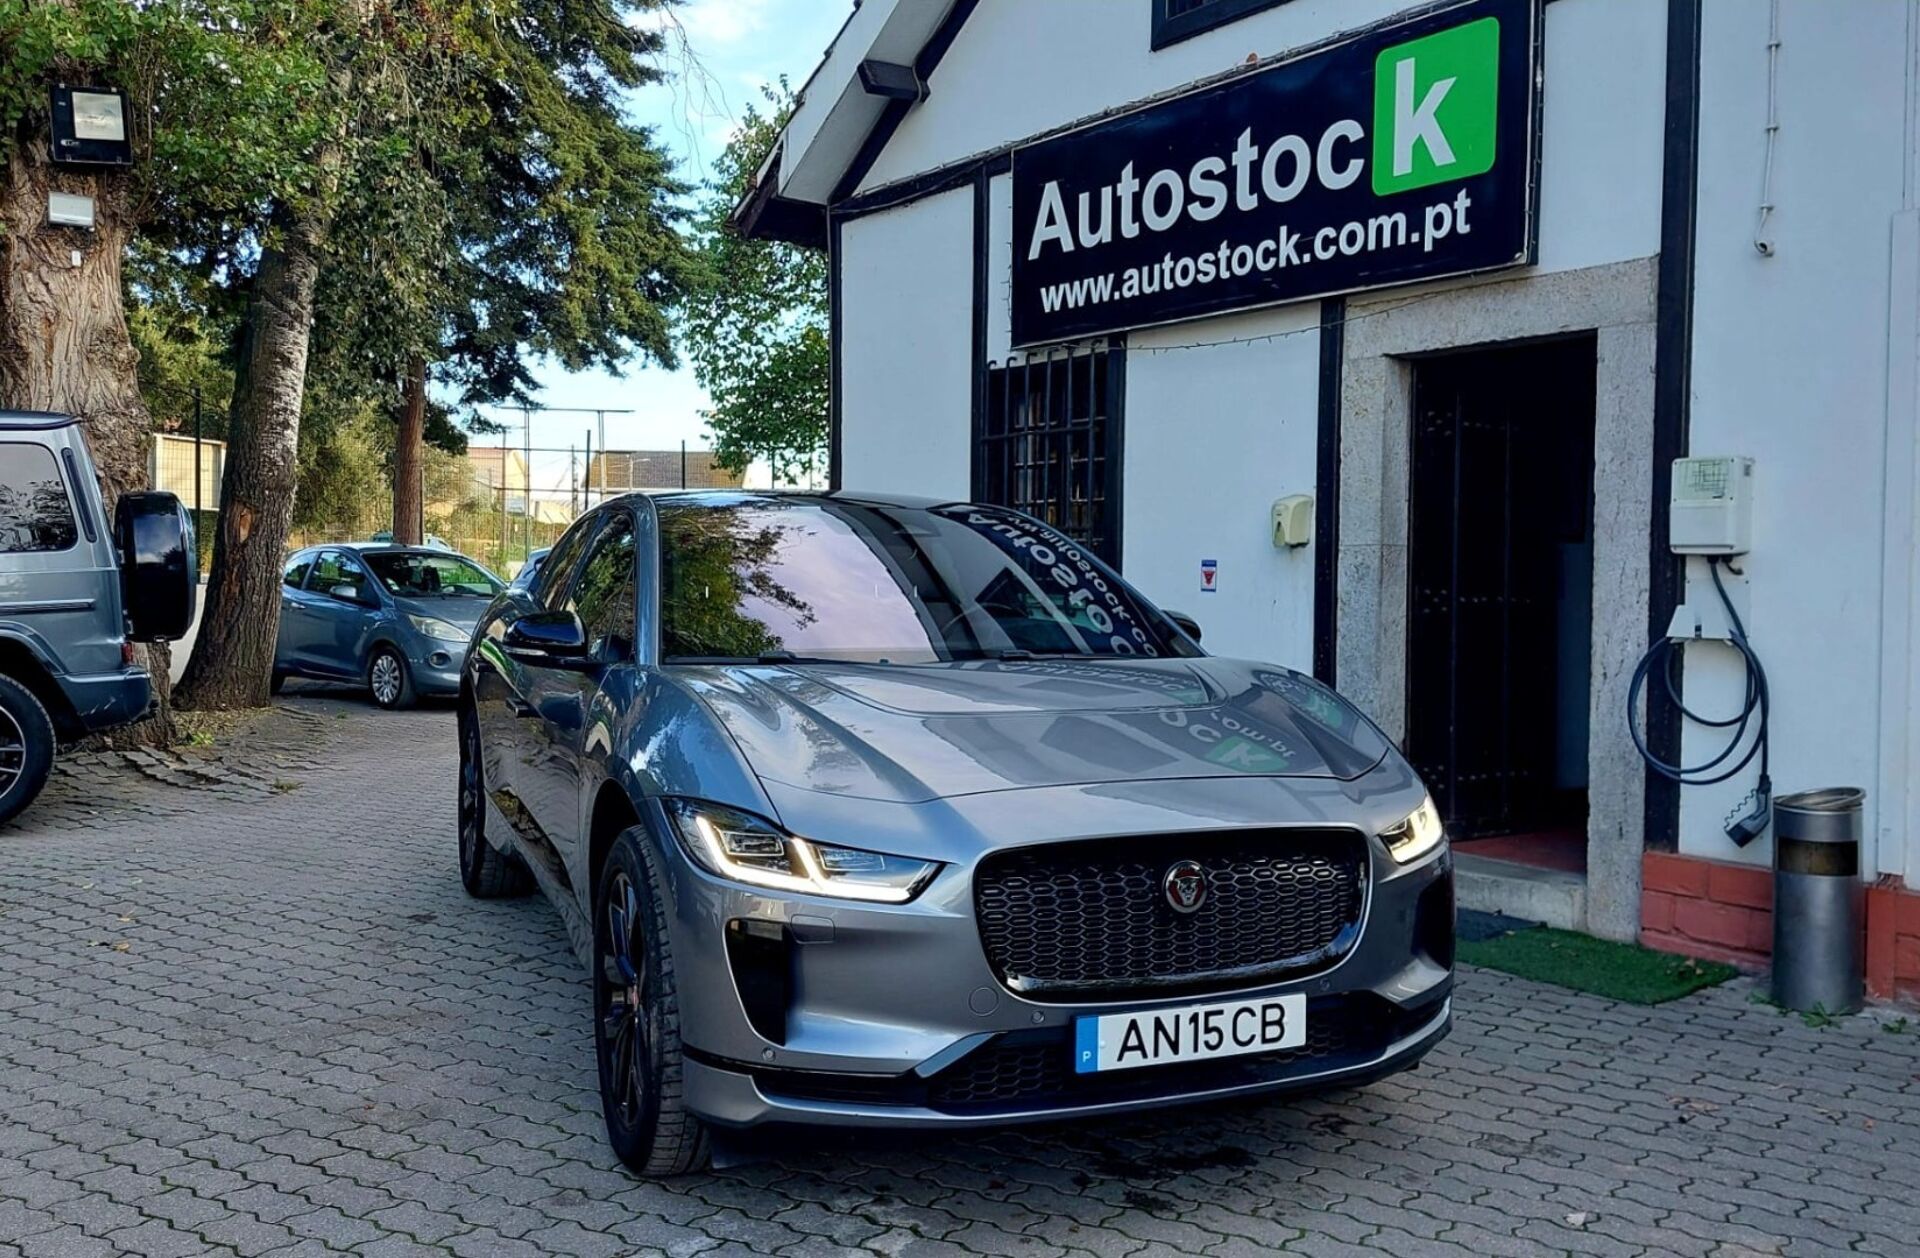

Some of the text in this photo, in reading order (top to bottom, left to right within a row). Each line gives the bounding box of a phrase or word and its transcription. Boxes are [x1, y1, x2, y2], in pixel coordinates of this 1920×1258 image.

[1028, 58, 1457, 260] Autostock
[1041, 188, 1471, 312] www.autostock.com.pt
[1082, 1003, 1285, 1062] P AN15CB
